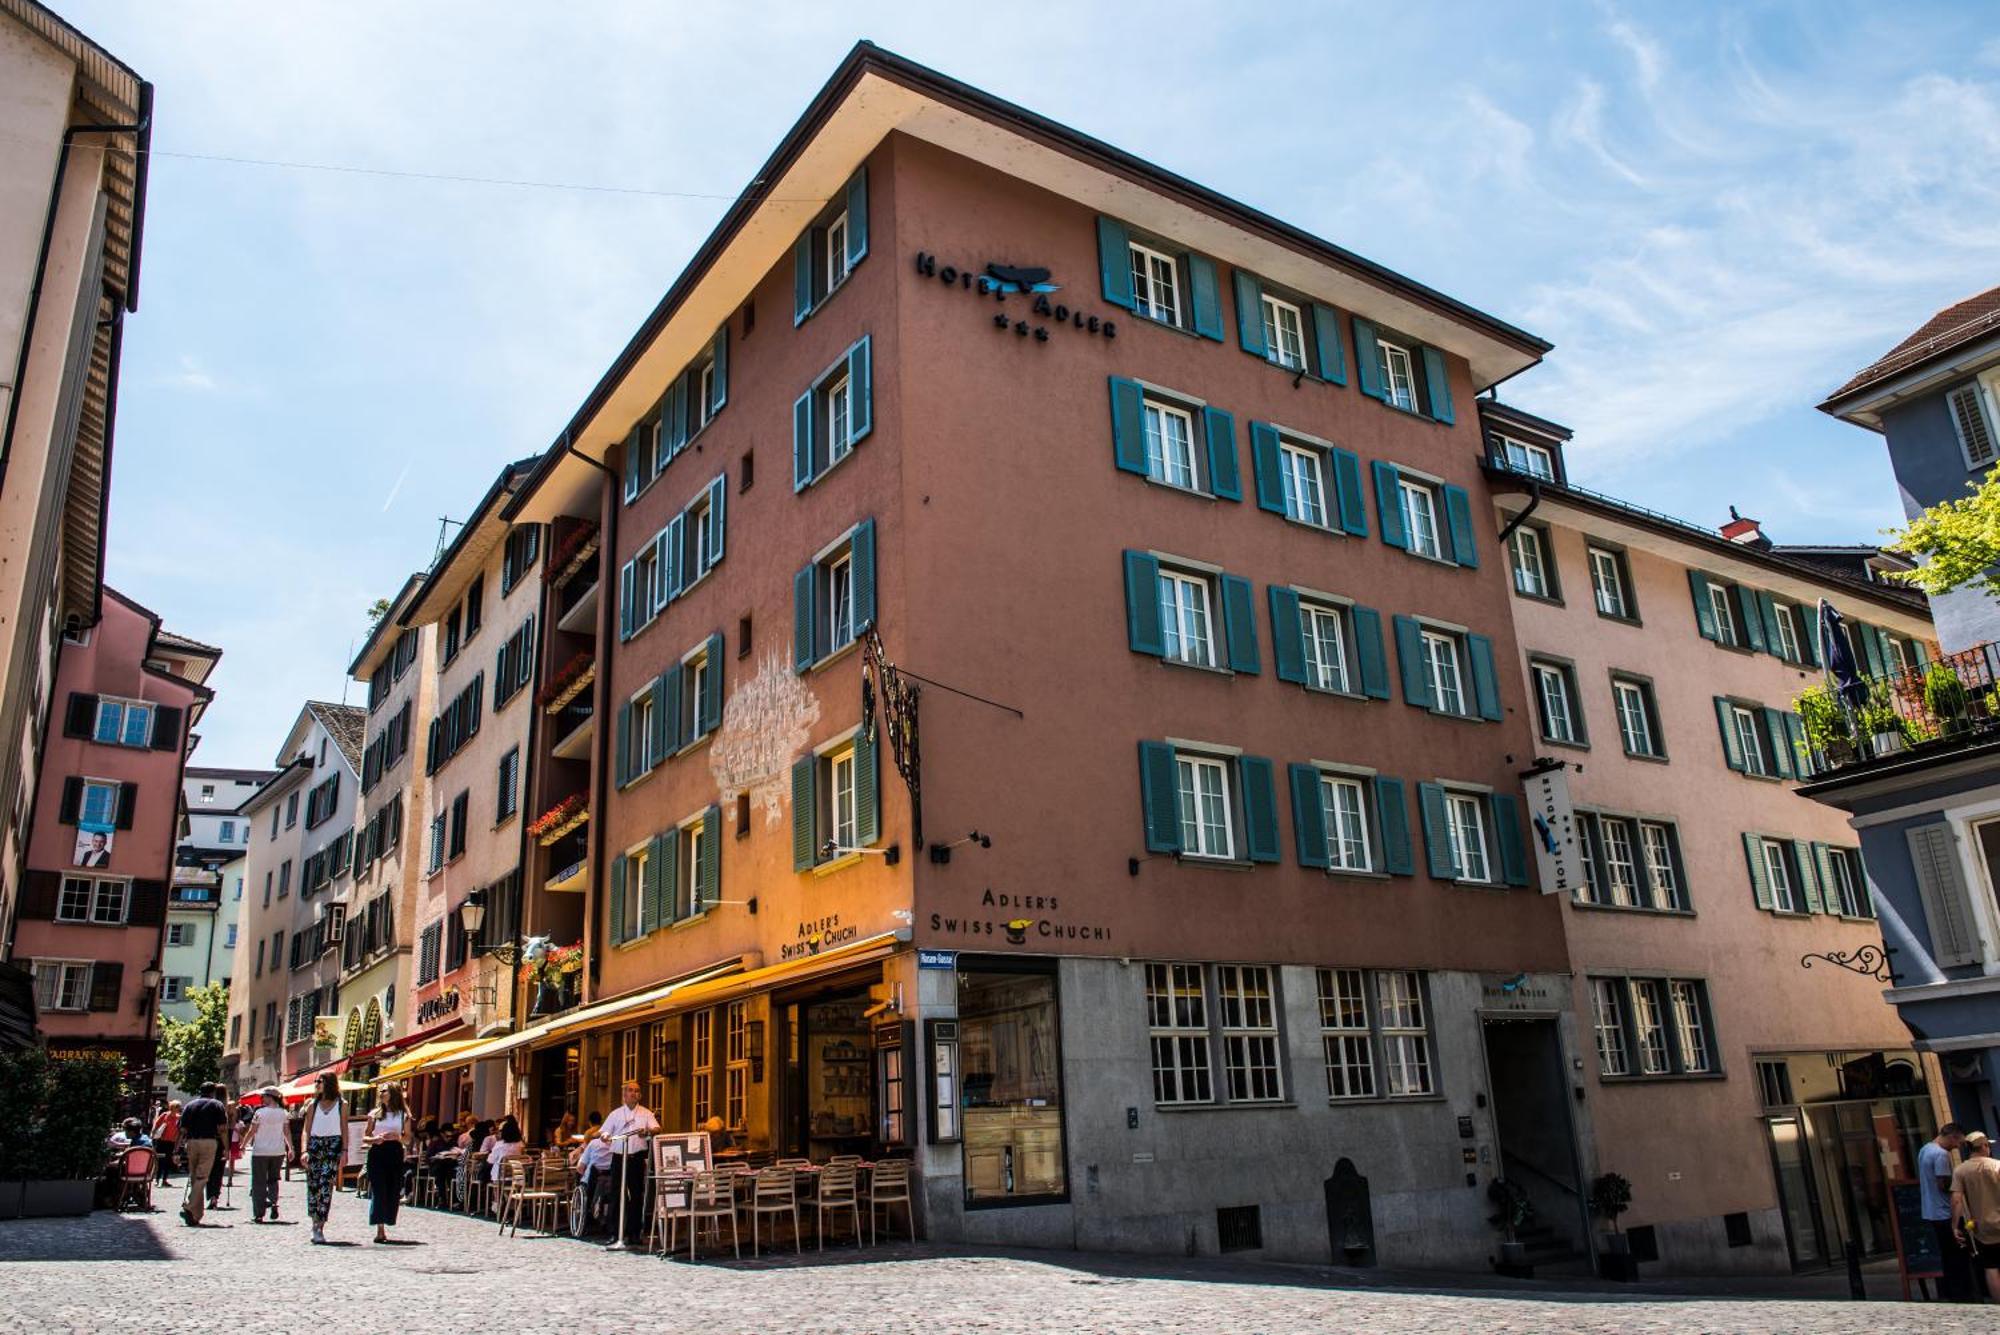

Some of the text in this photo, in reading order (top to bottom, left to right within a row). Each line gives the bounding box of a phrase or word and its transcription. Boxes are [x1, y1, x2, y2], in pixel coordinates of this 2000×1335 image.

[916, 251, 1117, 340] HOTEL ADLER
[1542, 778, 1567, 889] HOTEL ADLER
[982, 889, 1057, 909] ADLER'S
[798, 914, 838, 939] ADLER'S
[931, 914, 1111, 940] SWISS CHUCHI
[781, 925, 857, 959] SWISS CHUCHI
